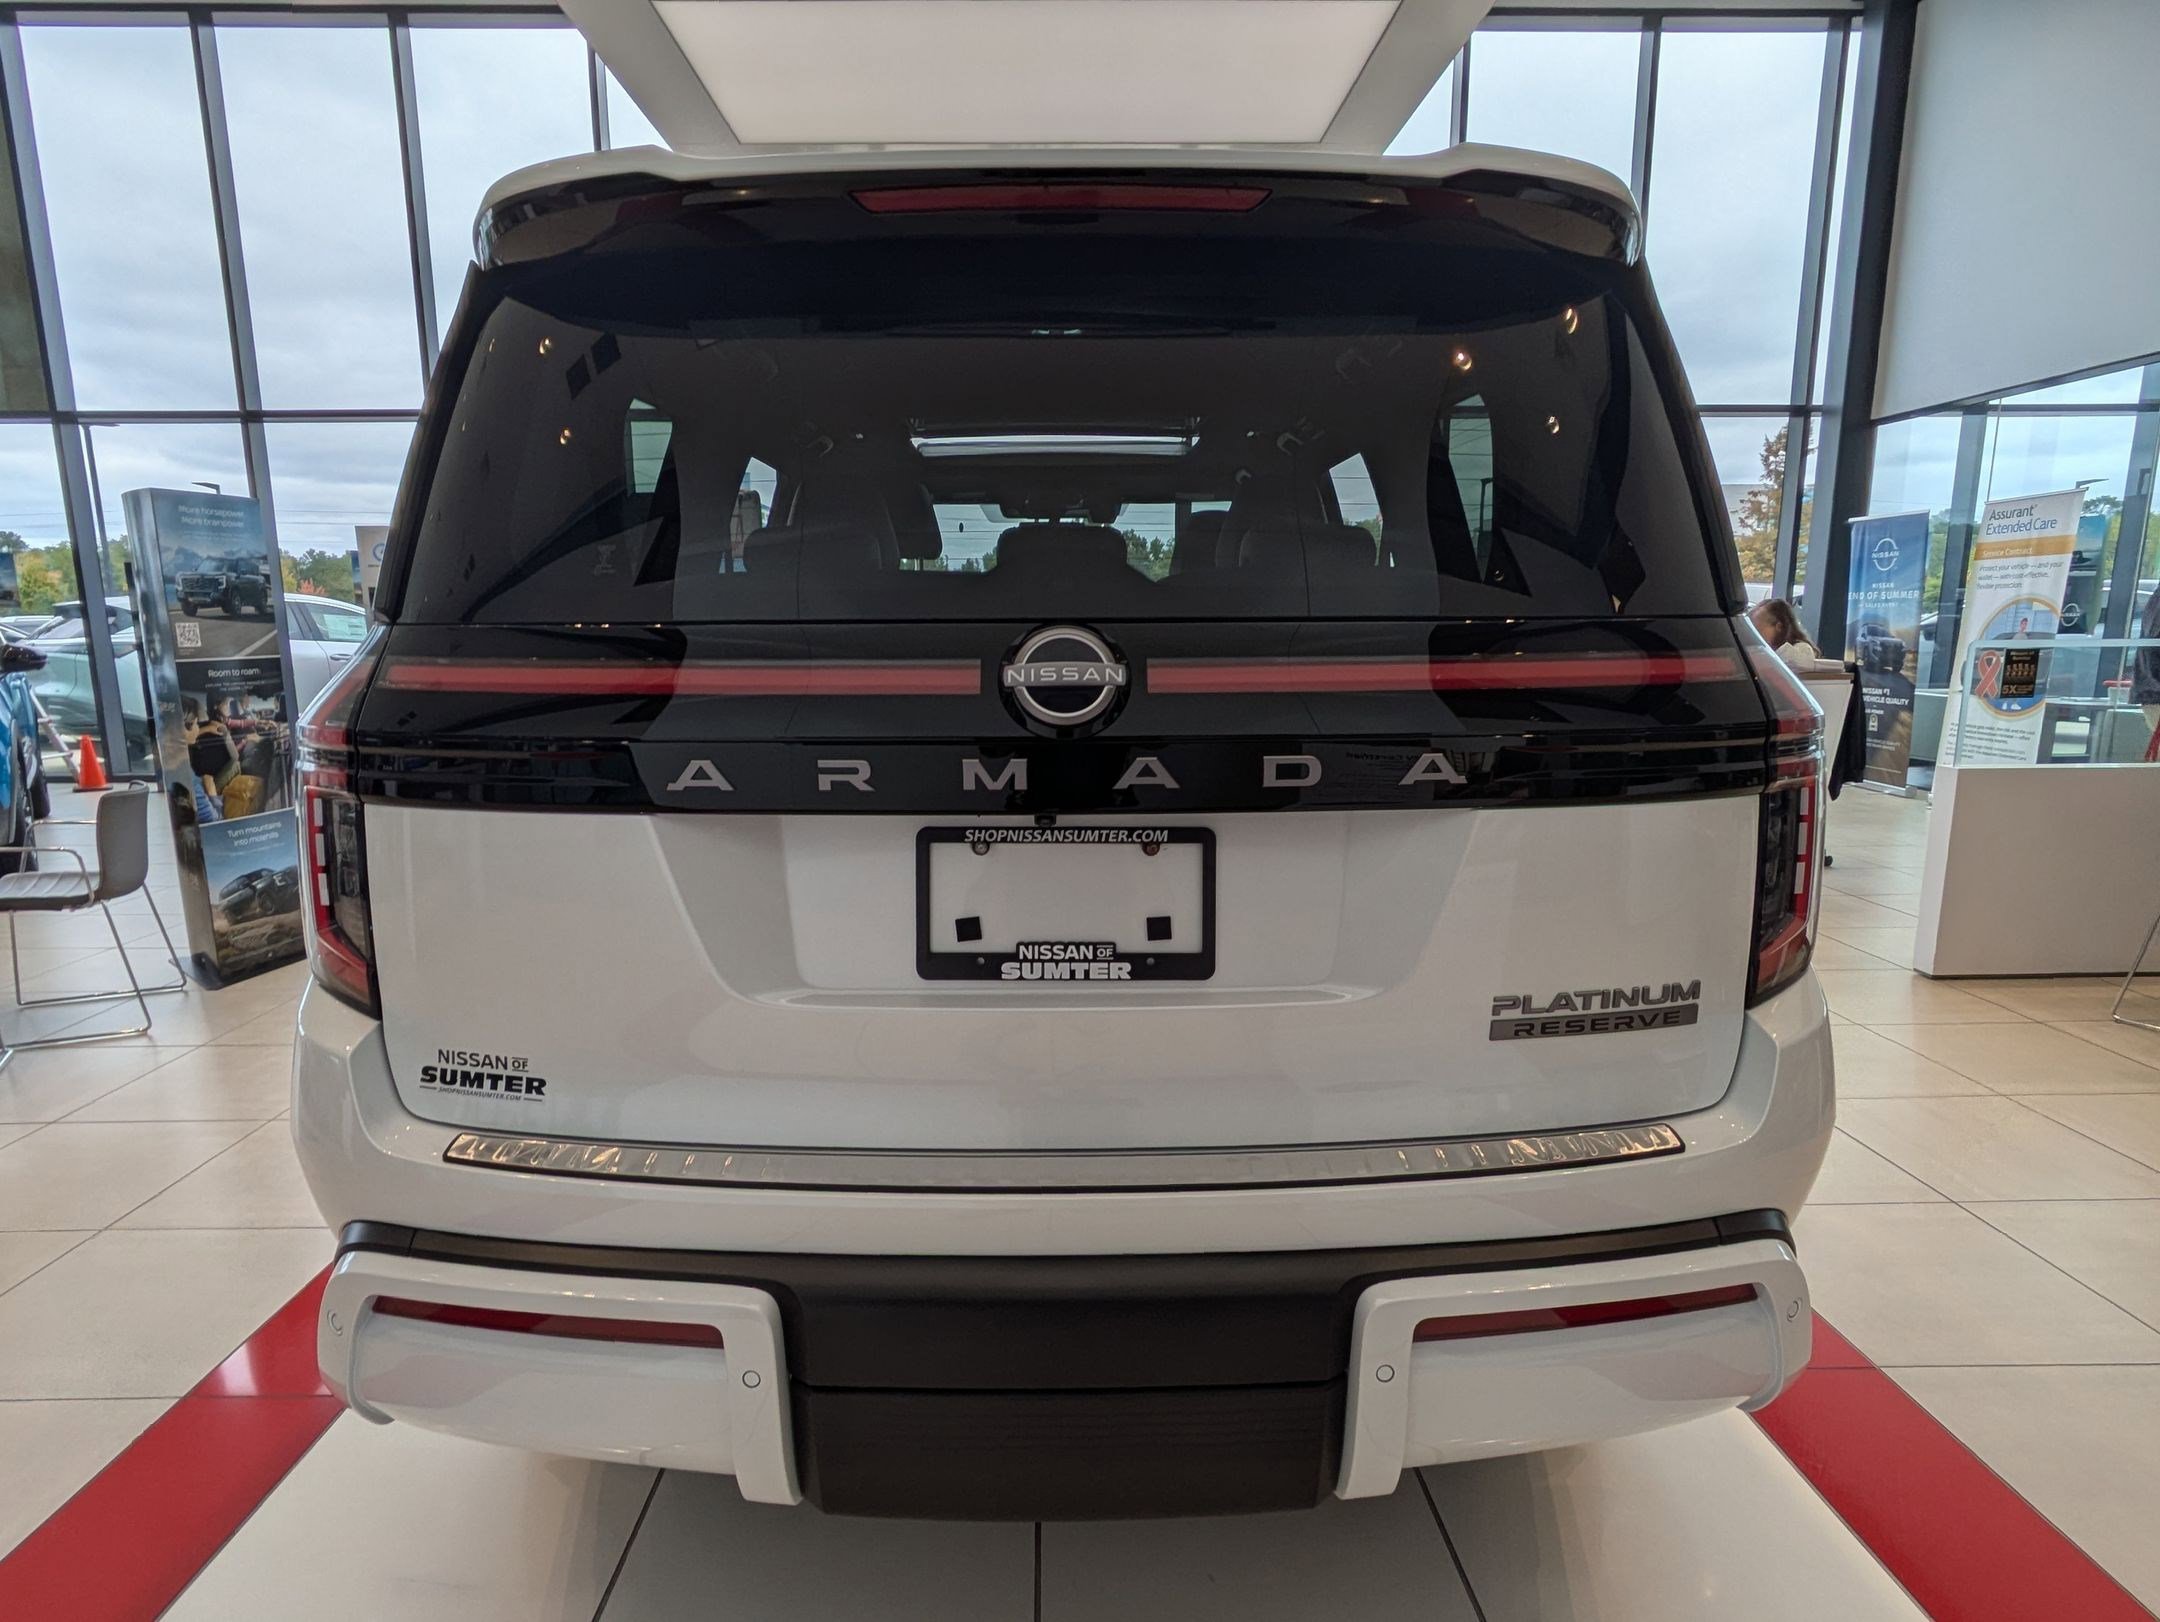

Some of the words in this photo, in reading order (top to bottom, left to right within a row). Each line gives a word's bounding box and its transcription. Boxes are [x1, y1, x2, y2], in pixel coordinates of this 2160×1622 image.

[1988, 505, 2035, 521] Assurant
[1985, 519, 2032, 536] Extended
[2033, 518, 2058, 531] Care
[1871, 550, 1899, 559] NISSAN
[1848, 591, 1865, 600] END
[1866, 591, 1879, 600] OF
[1880, 590, 1920, 600] SUMMER
[207, 669, 232, 678] Room
[1007, 667, 1123, 683] NISSAN
[1862, 687, 1883, 695] NISSAN
[1862, 695, 1885, 704] VEHICLE
[1885, 697, 1910, 706] QUALITY
[666, 753, 1468, 791] ARMADA
[227, 829, 244, 838] Turn
[964, 829, 1169, 843] SHOPNISSANSUMTER.COM
[1019, 944, 1093, 960] NISSAN
[1097, 948, 1113, 957] OF
[1001, 961, 1132, 980] SUMTER
[1491, 979, 1702, 1017] PLATINUM
[1513, 1009, 1681, 1037] RESERVE
[437, 1048, 508, 1070] NISSAN
[511, 1059, 529, 1070] OF
[420, 1065, 547, 1096] SUMTER
[438, 1086, 522, 1101] SHOPNISSANSUMTER.COM
